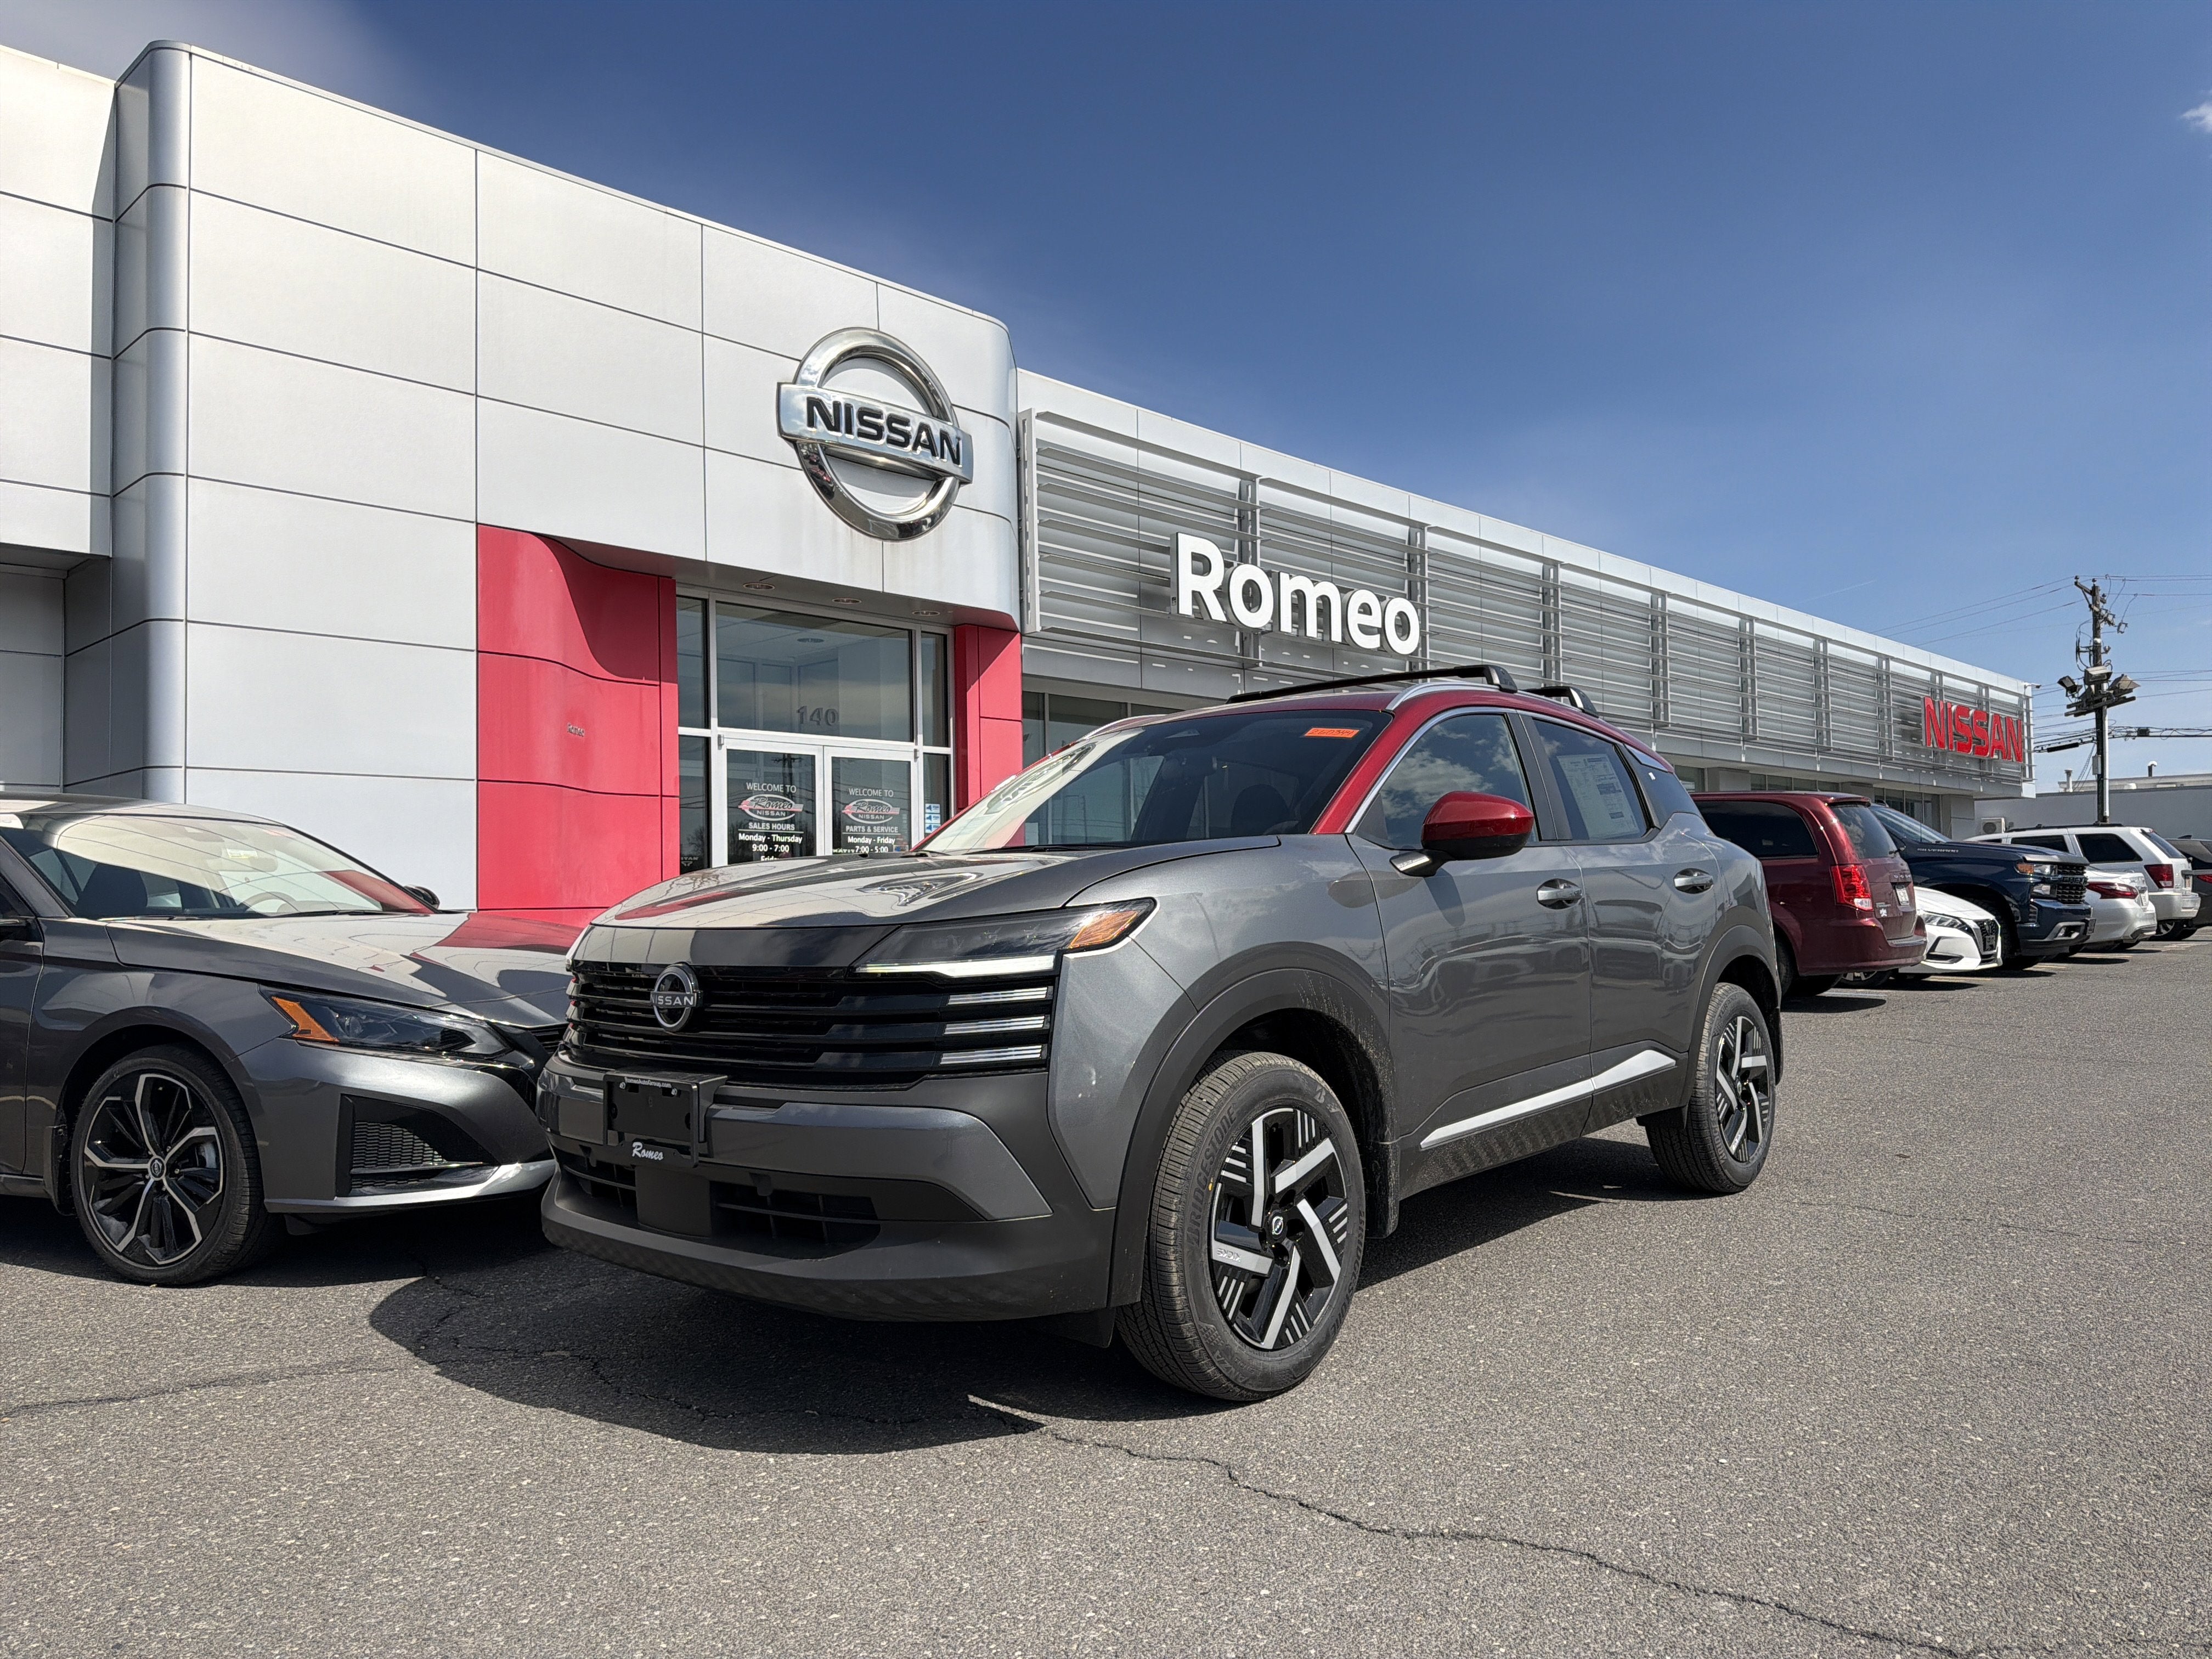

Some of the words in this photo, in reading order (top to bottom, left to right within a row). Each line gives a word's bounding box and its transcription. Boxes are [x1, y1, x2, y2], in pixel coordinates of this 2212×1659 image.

[806, 396, 962, 466] NISSAN
[1174, 532, 1420, 655] Romeo
[797, 706, 839, 726] 140
[1923, 696, 2023, 763] NISSAN
[746, 782, 783, 792] WELCOME
[786, 785, 797, 793] TO
[848, 788, 882, 797] WELCOME
[753, 795, 793, 809] Romeo
[855, 800, 891, 813] Romeo
[738, 833, 766, 843] Monday
[771, 834, 803, 844] Thursday
[848, 836, 872, 844] Monday
[752, 844, 768, 852] 9:00
[651, 993, 693, 1005] NISSAN
[631, 1142, 664, 1161] Romeo
